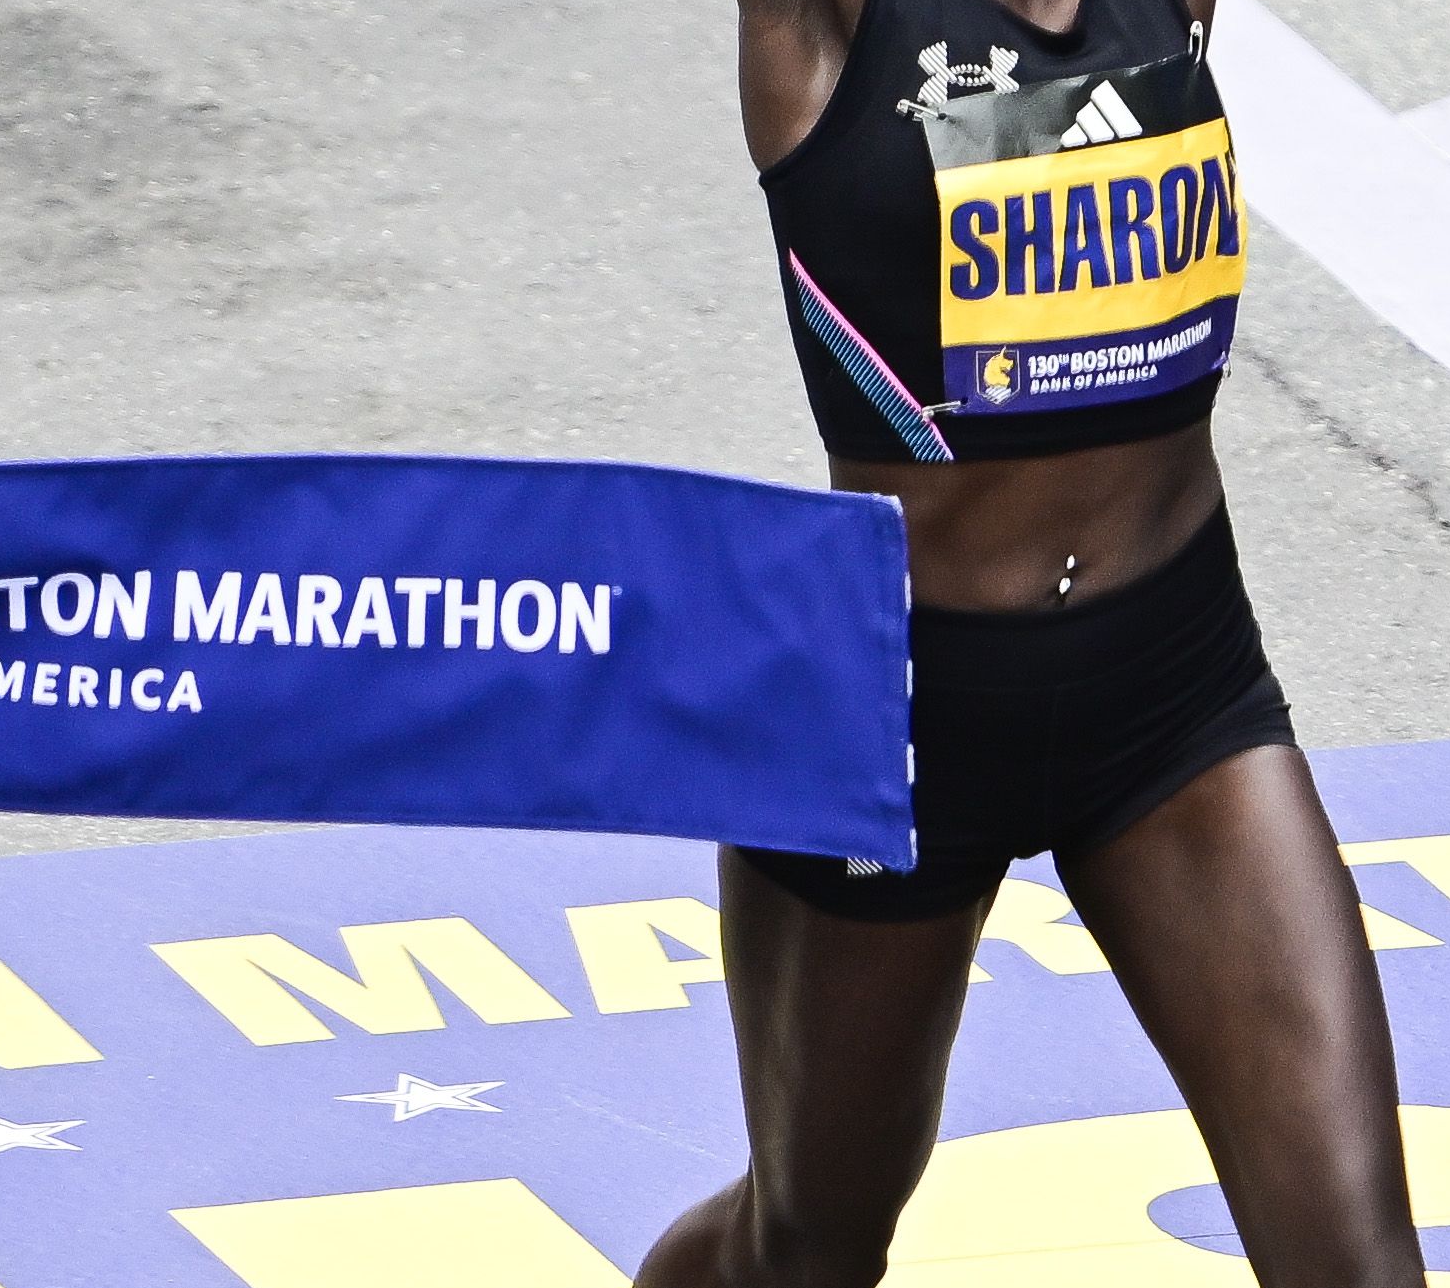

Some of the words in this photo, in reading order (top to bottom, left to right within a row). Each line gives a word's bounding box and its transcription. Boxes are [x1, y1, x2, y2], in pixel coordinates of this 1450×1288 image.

[950, 157, 1240, 300] SHARON
[1028, 352, 1070, 378] 130TH
[1070, 342, 1144, 375] BOSTON
[1147, 317, 1212, 361] MARATHON
[1030, 377, 1071, 395] BANK
[1073, 373, 1093, 391] OF
[1095, 364, 1158, 387] AMERICA
[173, 571, 611, 655] MARATHON
